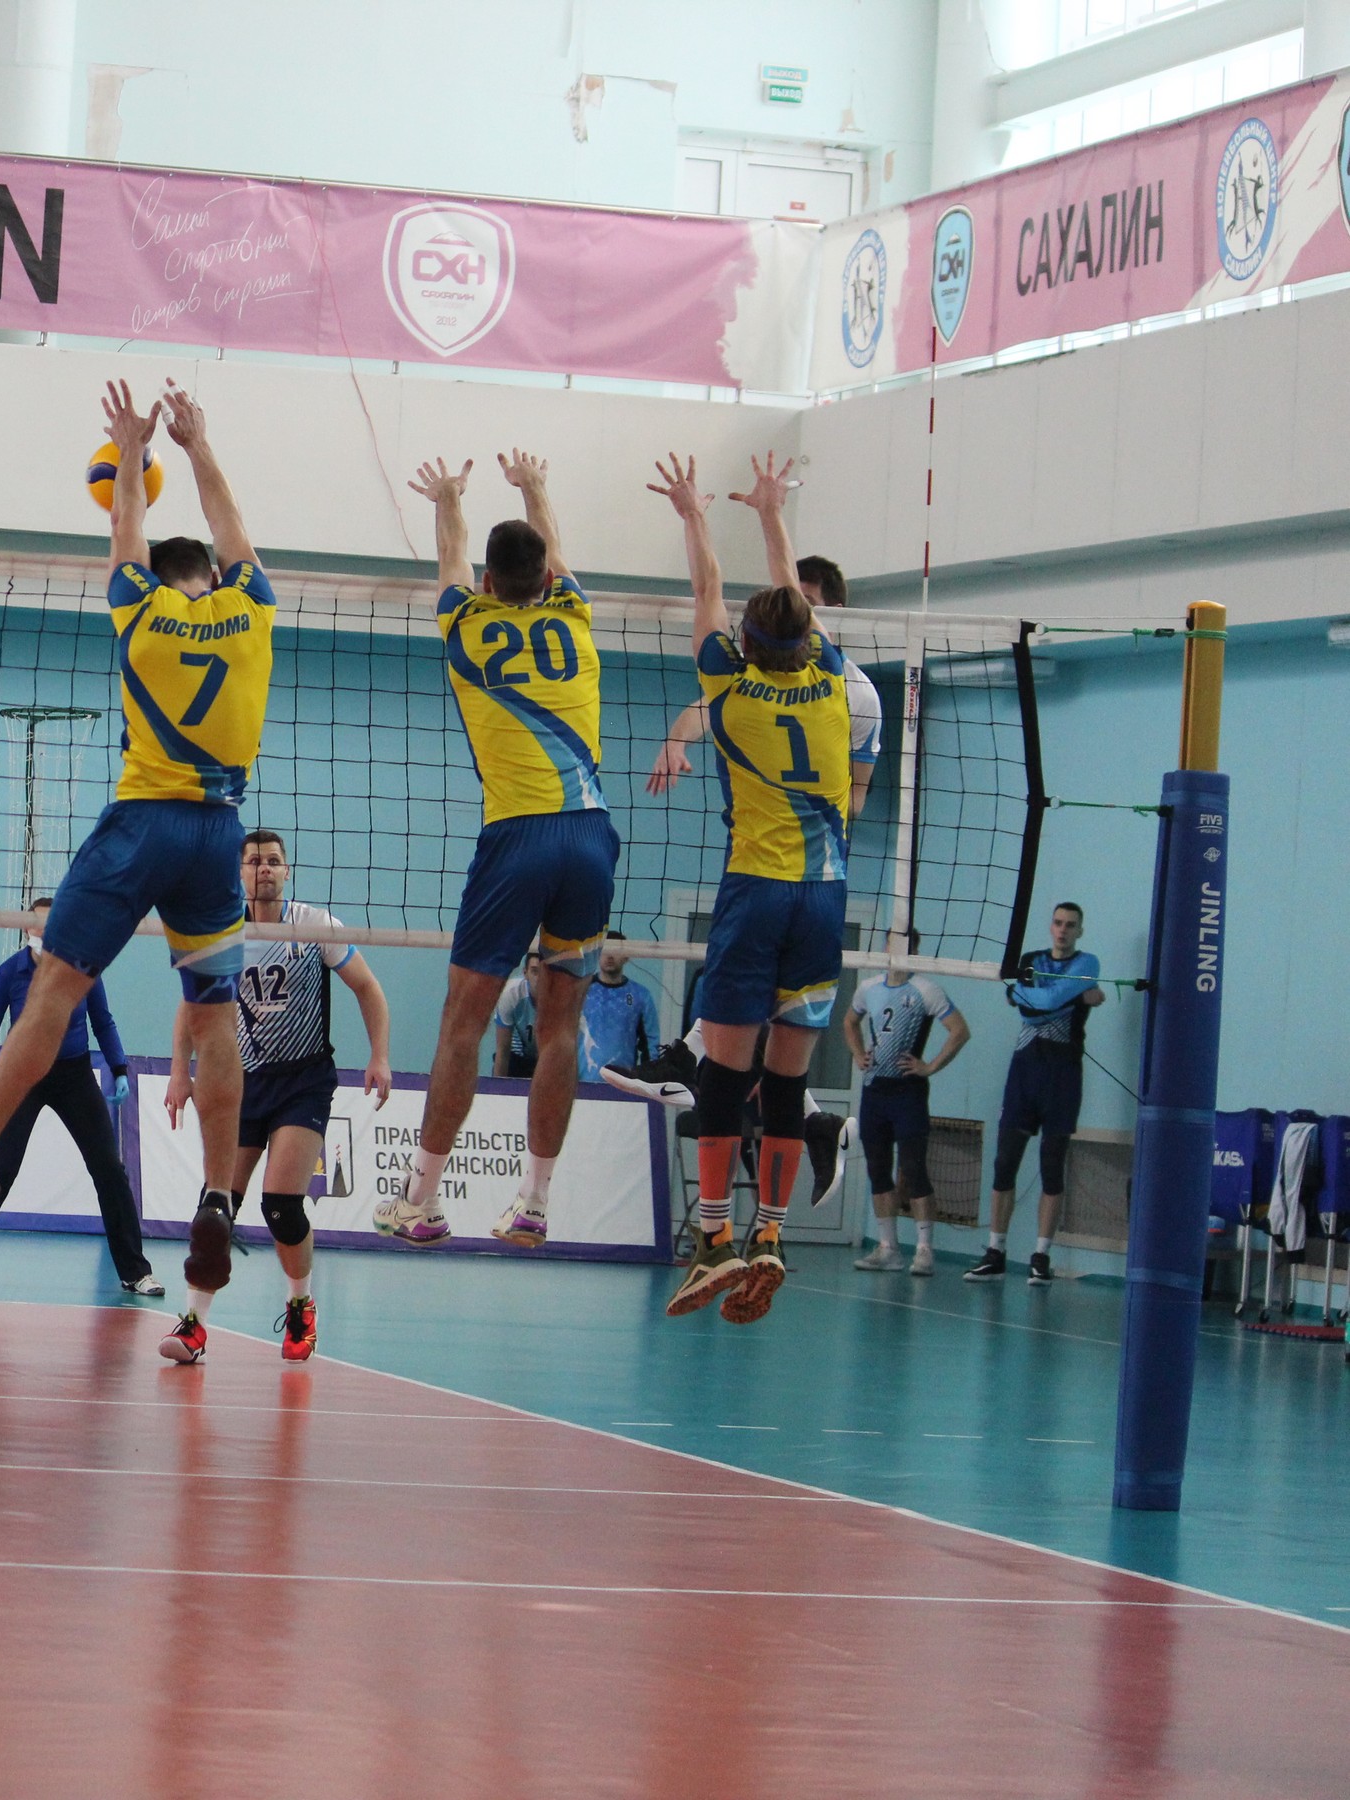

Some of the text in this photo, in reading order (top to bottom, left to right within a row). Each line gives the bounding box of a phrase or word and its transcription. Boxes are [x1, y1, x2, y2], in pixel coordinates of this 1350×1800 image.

[1016, 179, 1164, 297] САХАЛИН
[420, 289, 475, 301] САХАЛИН
[435, 315, 457, 327] 2012
[481, 616, 579, 688] 20
[178, 651, 230, 727] 7
[775, 714, 820, 783] 1
[1196, 881, 1221, 993] JINLING
[244, 963, 290, 1004] 12
[881, 1007, 894, 1033] 2
[375, 1151, 523, 1178] САХИНСКОЙ
[376, 1177, 468, 1200] ОБТИ
